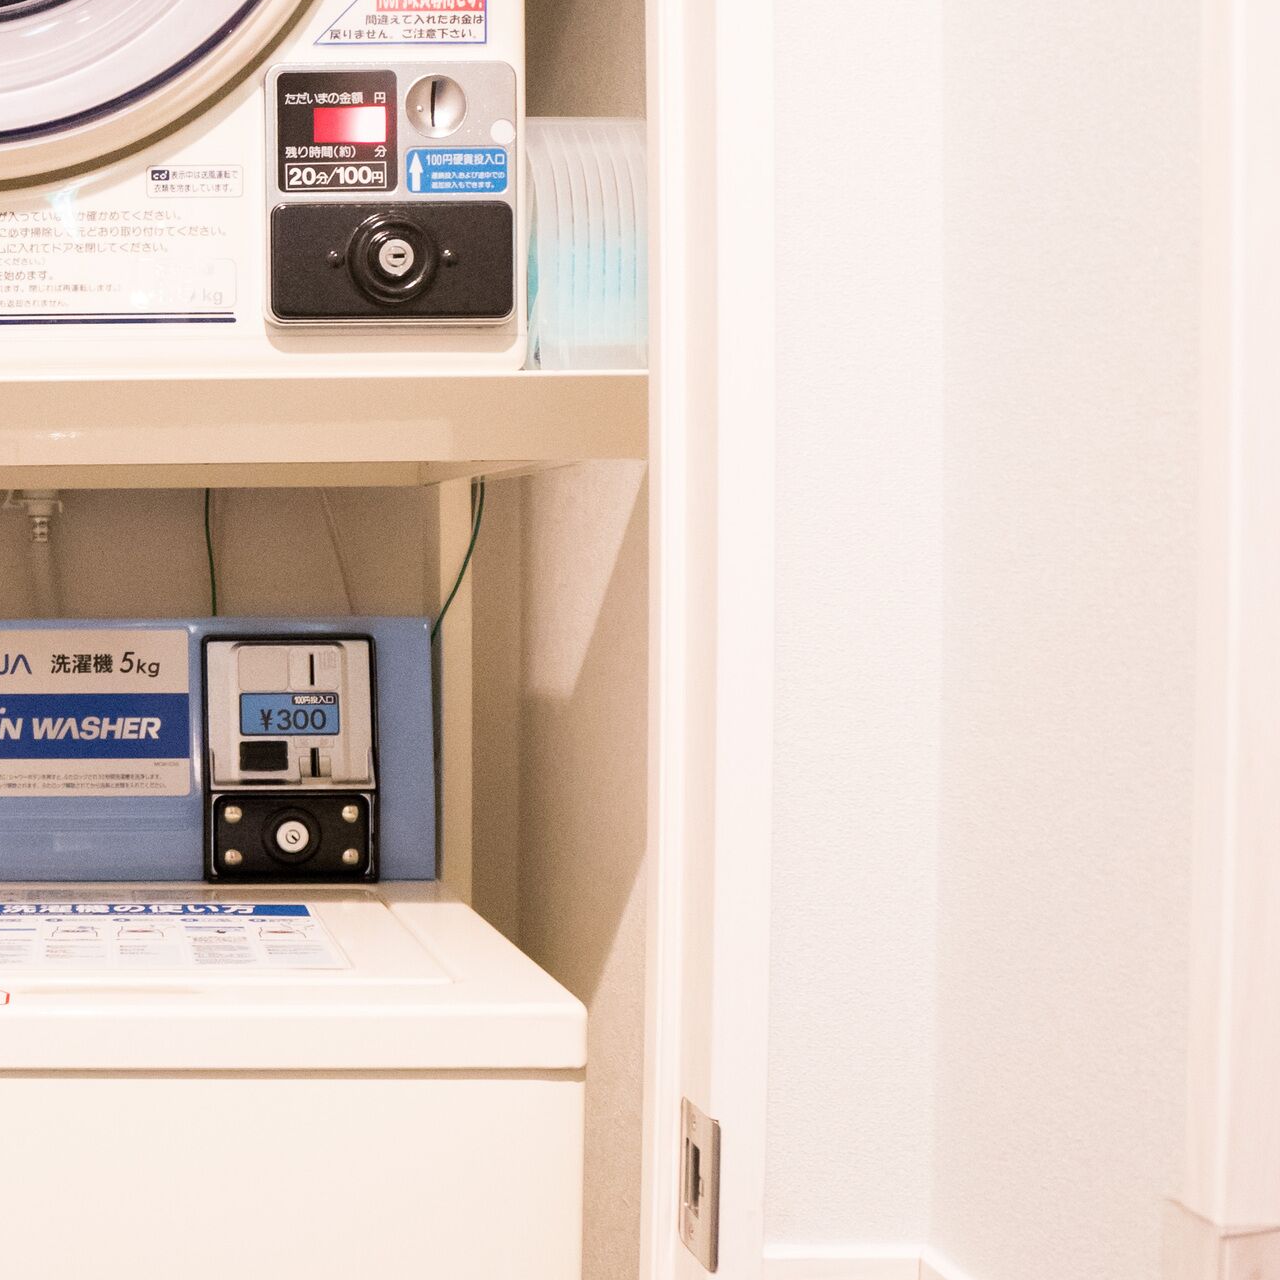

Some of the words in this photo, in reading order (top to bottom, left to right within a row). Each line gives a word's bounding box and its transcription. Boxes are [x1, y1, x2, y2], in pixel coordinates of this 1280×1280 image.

[365, 14, 484, 25] 間違えて入れたお金は
[285, 92, 364, 105] ただいまの金額
[374, 92, 386, 103] 円
[285, 145, 357, 159] 残り時間（約）
[374, 145, 387, 158] 分
[289, 166, 384, 186] 20分/100円
[50, 653, 113, 675] 洗濯機
[119, 651, 161, 678] 5kg
[260, 708, 327, 731] ¥300
[33, 716, 162, 741] WASHER
[3, 904, 257, 914] 洗濯機の使い方
